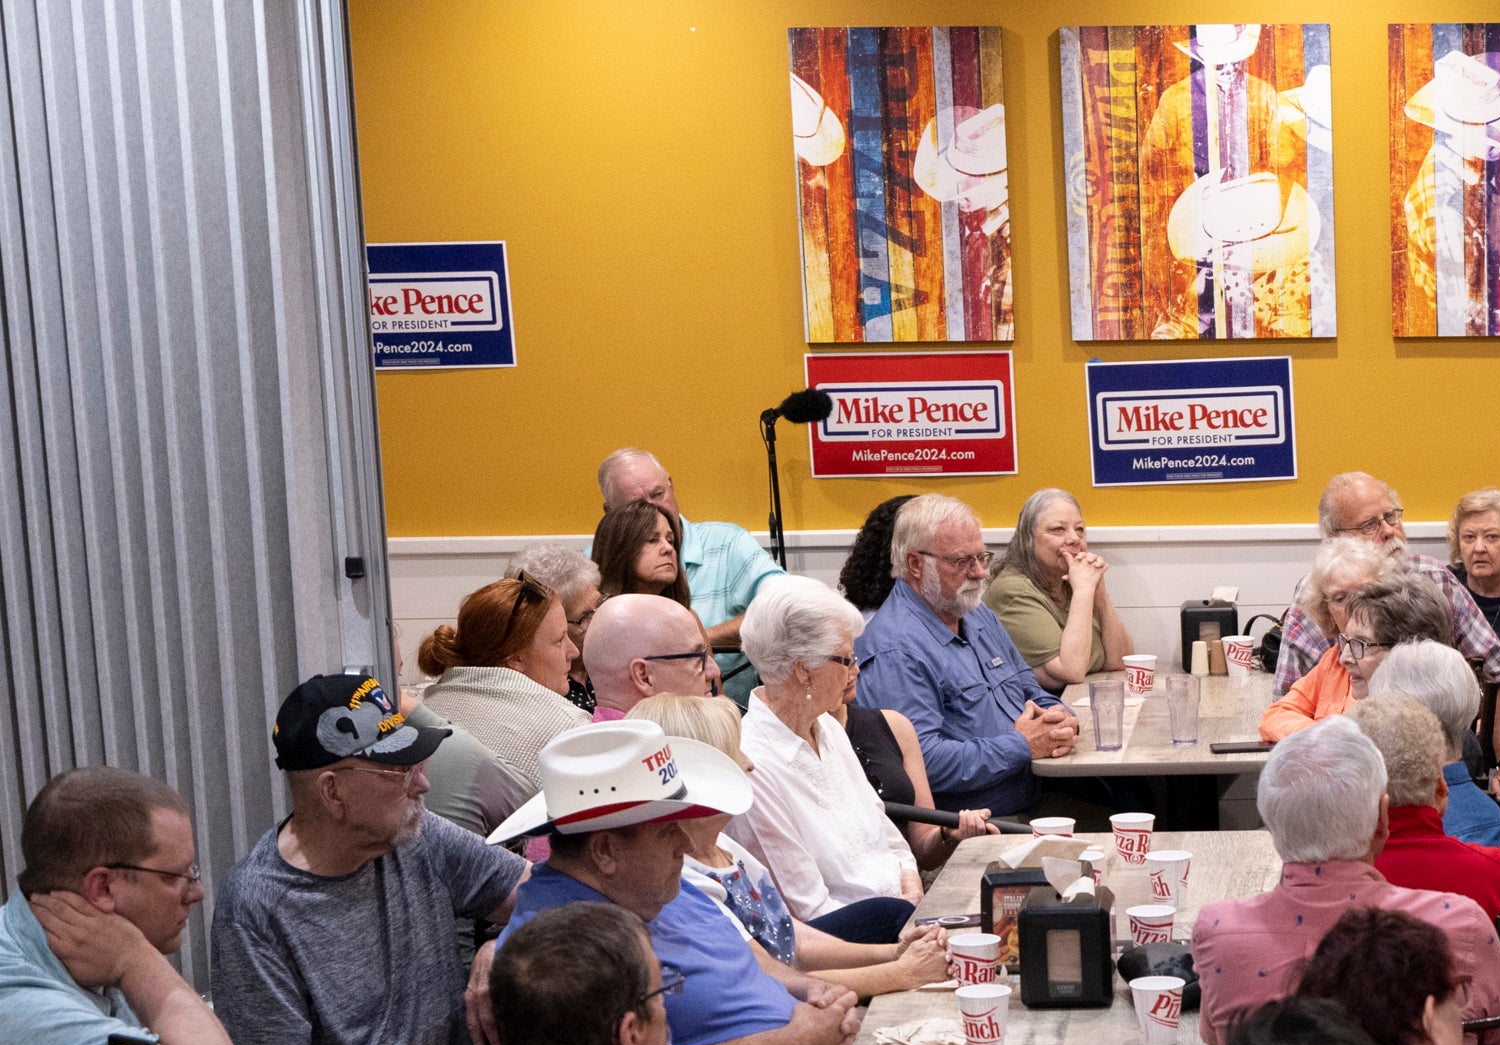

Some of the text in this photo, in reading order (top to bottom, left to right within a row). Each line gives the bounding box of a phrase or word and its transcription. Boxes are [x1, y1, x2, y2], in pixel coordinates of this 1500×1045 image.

[369, 288, 484, 315] ke Pence
[372, 320, 448, 330] OR PRESIDENT
[375, 341, 473, 354] Pence2024.com
[836, 397, 988, 424] Mike Pence
[1116, 403, 1267, 432] Mike Pence
[871, 428, 953, 438] FOR PRESIDENT
[1152, 434, 1233, 446] FOR PRESIDENT
[852, 449, 975, 461] MikePence2024.com
[1132, 455, 1255, 470] MikePence2024.com
[1226, 644, 1252, 662] Pizz
[378, 714, 405, 733] DIVIS
[642, 743, 671, 772] TRU
[658, 761, 677, 786] 20
[1114, 834, 1135, 852] zza
[964, 961, 996, 985] Ran
[1150, 993, 1181, 1019] Piz
[965, 1015, 1000, 1039] nch
